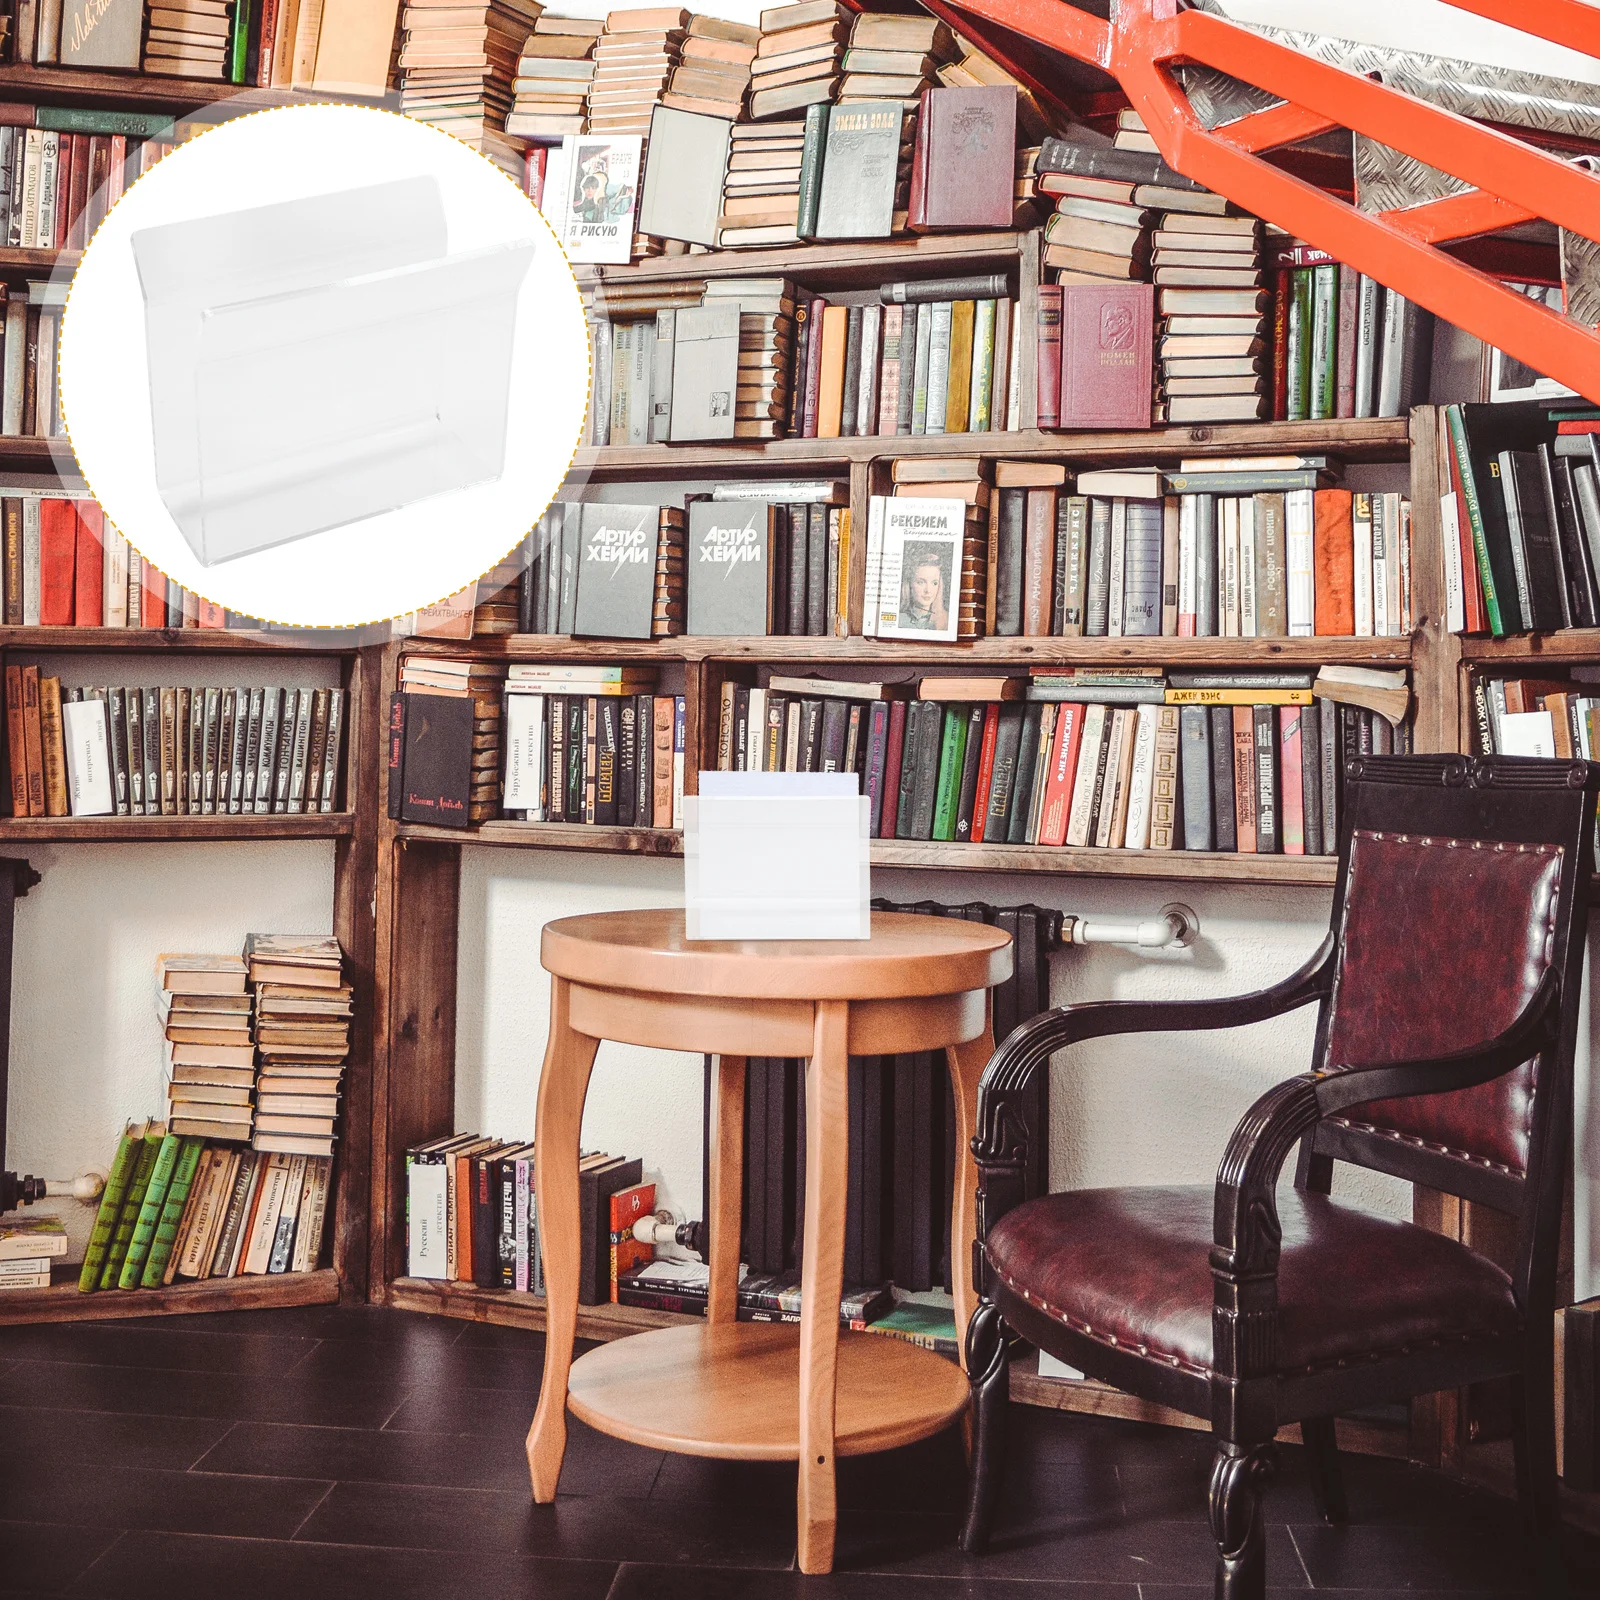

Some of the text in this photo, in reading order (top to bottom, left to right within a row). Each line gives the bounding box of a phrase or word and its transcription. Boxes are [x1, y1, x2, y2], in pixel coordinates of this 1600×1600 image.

[835, 112, 895, 131] ЭМИЛЬ ЗОЛЯ
[25, 164, 36, 244] ЧИНГИЗ АЙТМАТОВ
[570, 226, 617, 236] Я РИСУЮ
[8, 512, 17, 559] СИМОНОВ
[891, 515, 948, 528] РЕКВИЕМ
[1471, 513, 1481, 528] на
[1032, 547, 1042, 600] АНАТОЛИЙ
[1112, 560, 1120, 582] Дочь
[1475, 530, 1494, 600] Вологодчина
[1173, 692, 1197, 700] ДЖЕК
[1201, 692, 1221, 700] ВЭНС
[1475, 685, 1487, 730] И ЖИЗНЬ
[165, 716, 173, 745] ХИКМЕТ
[248, 718, 258, 767] ЧИЧЕРИН
[262, 720, 274, 768] КОММУНИСТЫ
[280, 720, 293, 770] ГОНЧАРОВ
[296, 720, 307, 768] ВАШИНГТОН
[313, 720, 323, 767] ФОЛКНЕР
[326, 730, 336, 765] ЛАВРОВ
[719, 698, 731, 758] КОНСУЭЛО
[1057, 709, 1073, 782] Ф.НЕЗНАНСКИЙ
[85, 740, 93, 783] интересных
[511, 738, 520, 798] Зарубежный
[599, 746, 613, 802] МАСТЕРА
[1092, 741, 1108, 818] ЗАРУБЕЖНЫЙ ДЕТЕКТИВ
[73, 775, 81, 800] Жизнь
[1259, 753, 1273, 834] ЦЕЛЬ-ПРЕЗИДЕНТ
[232, 1164, 250, 1205] ГАЙДАР
[262, 1171, 280, 1226] Три мушкетера
[504, 1181, 513, 1233] ПРЕДТЕЧИ
[419, 1219, 429, 1257] Русский
